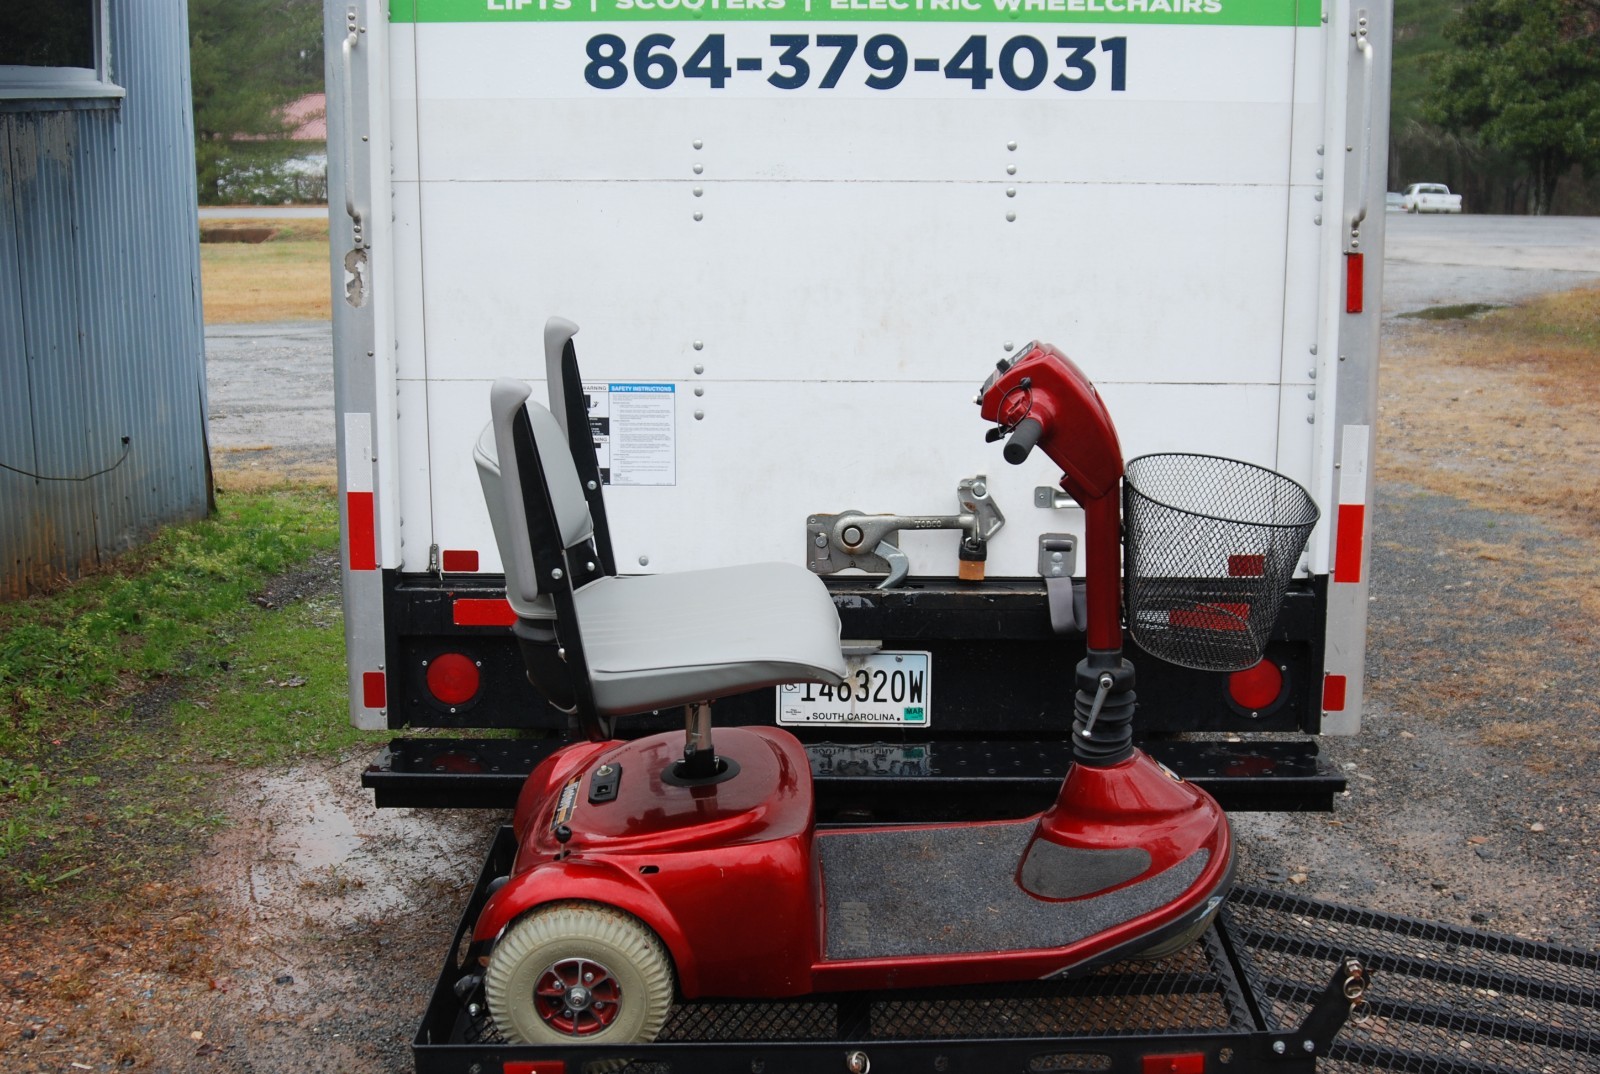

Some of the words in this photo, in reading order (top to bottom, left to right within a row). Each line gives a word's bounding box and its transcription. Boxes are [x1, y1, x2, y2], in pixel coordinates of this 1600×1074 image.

[488, 0, 572, 10] LIFTS
[616, 0, 786, 10] SCOOTERS
[831, 0, 982, 10] ELECTRIC
[993, 0, 1222, 12] WHEELCHAIRS
[584, 34, 1127, 91] 864-379-4031
[906, 707, 924, 715] MAR
[812, 712, 844, 720] SOUTH
[847, 713, 895, 721] CAROLINA
